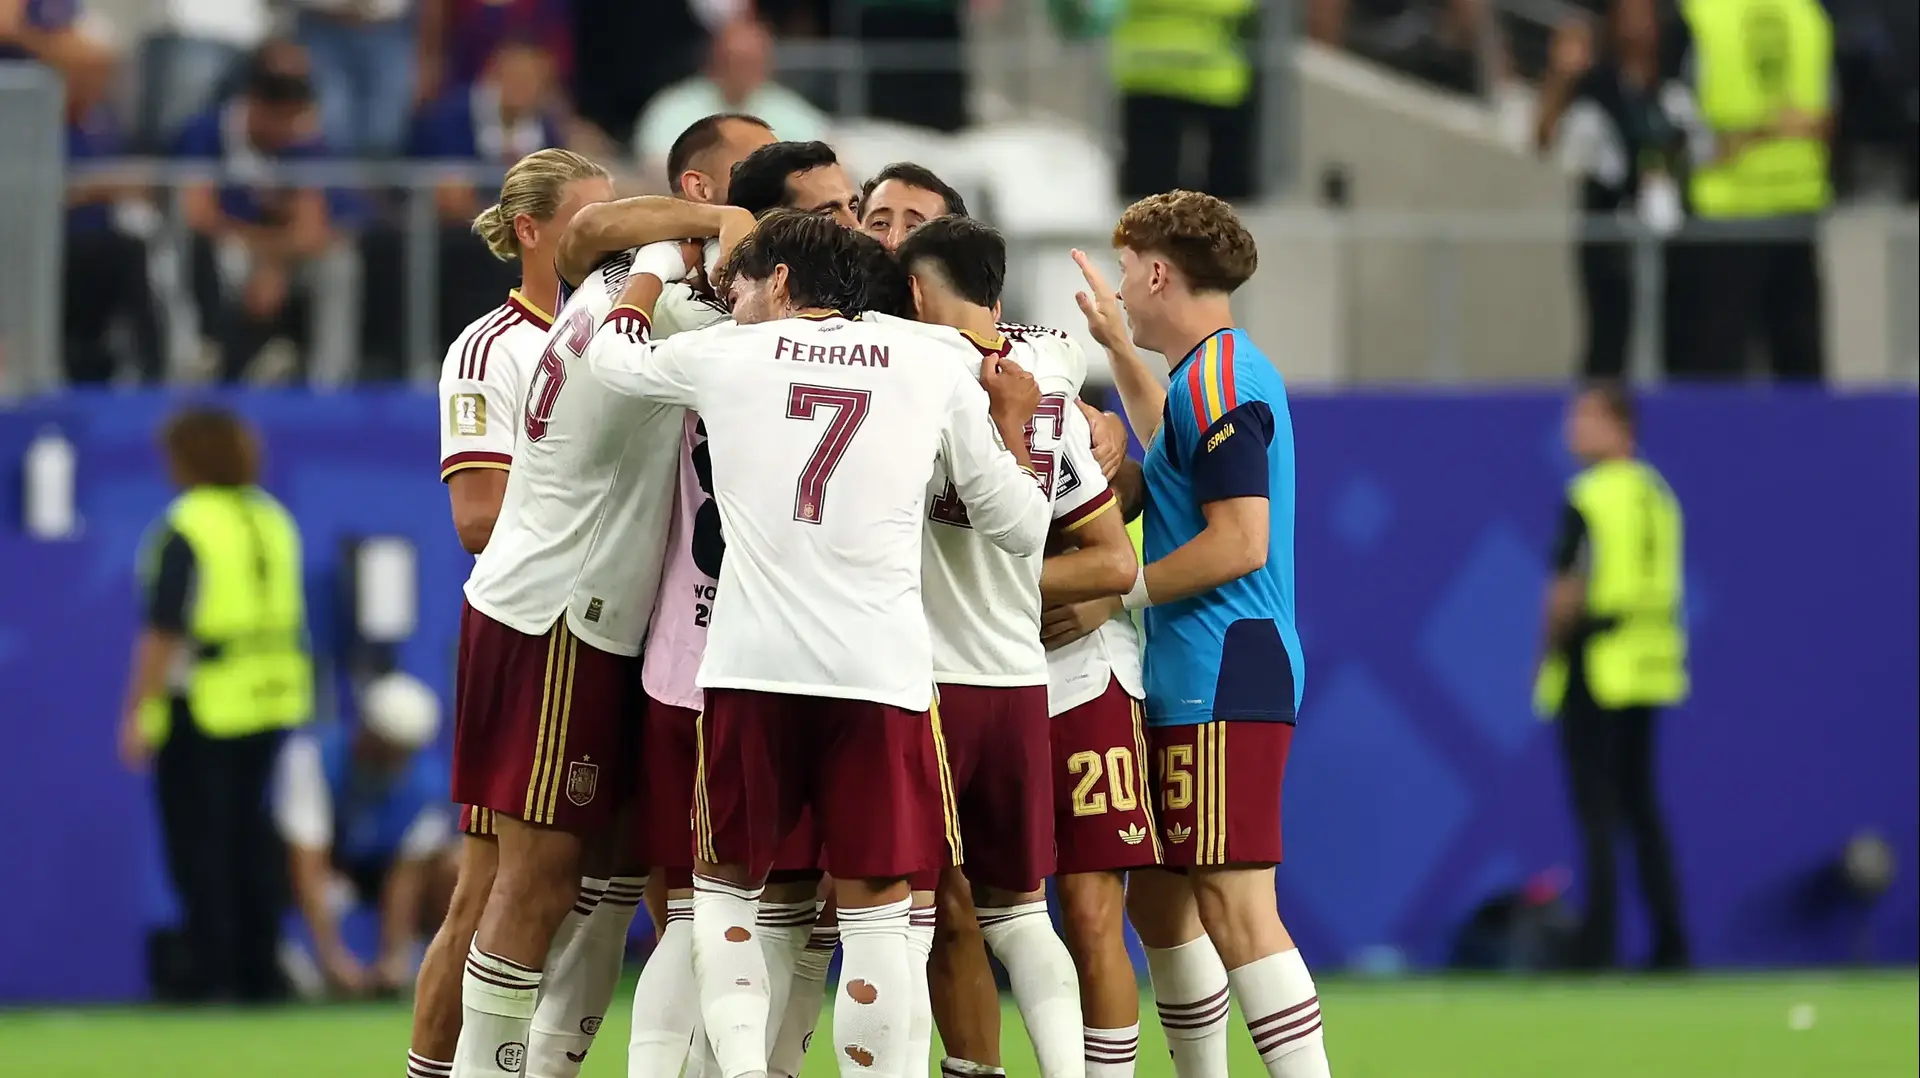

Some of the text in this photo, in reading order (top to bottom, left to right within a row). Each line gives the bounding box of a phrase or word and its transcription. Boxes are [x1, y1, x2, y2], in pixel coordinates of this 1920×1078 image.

[775, 336, 889, 368] FERRAN
[1207, 422, 1236, 453] ESPAÑA
[786, 382, 872, 525] 7
[693, 583, 718, 601] WO
[694, 603, 712, 628] 2
[1067, 746, 1138, 817] 20
